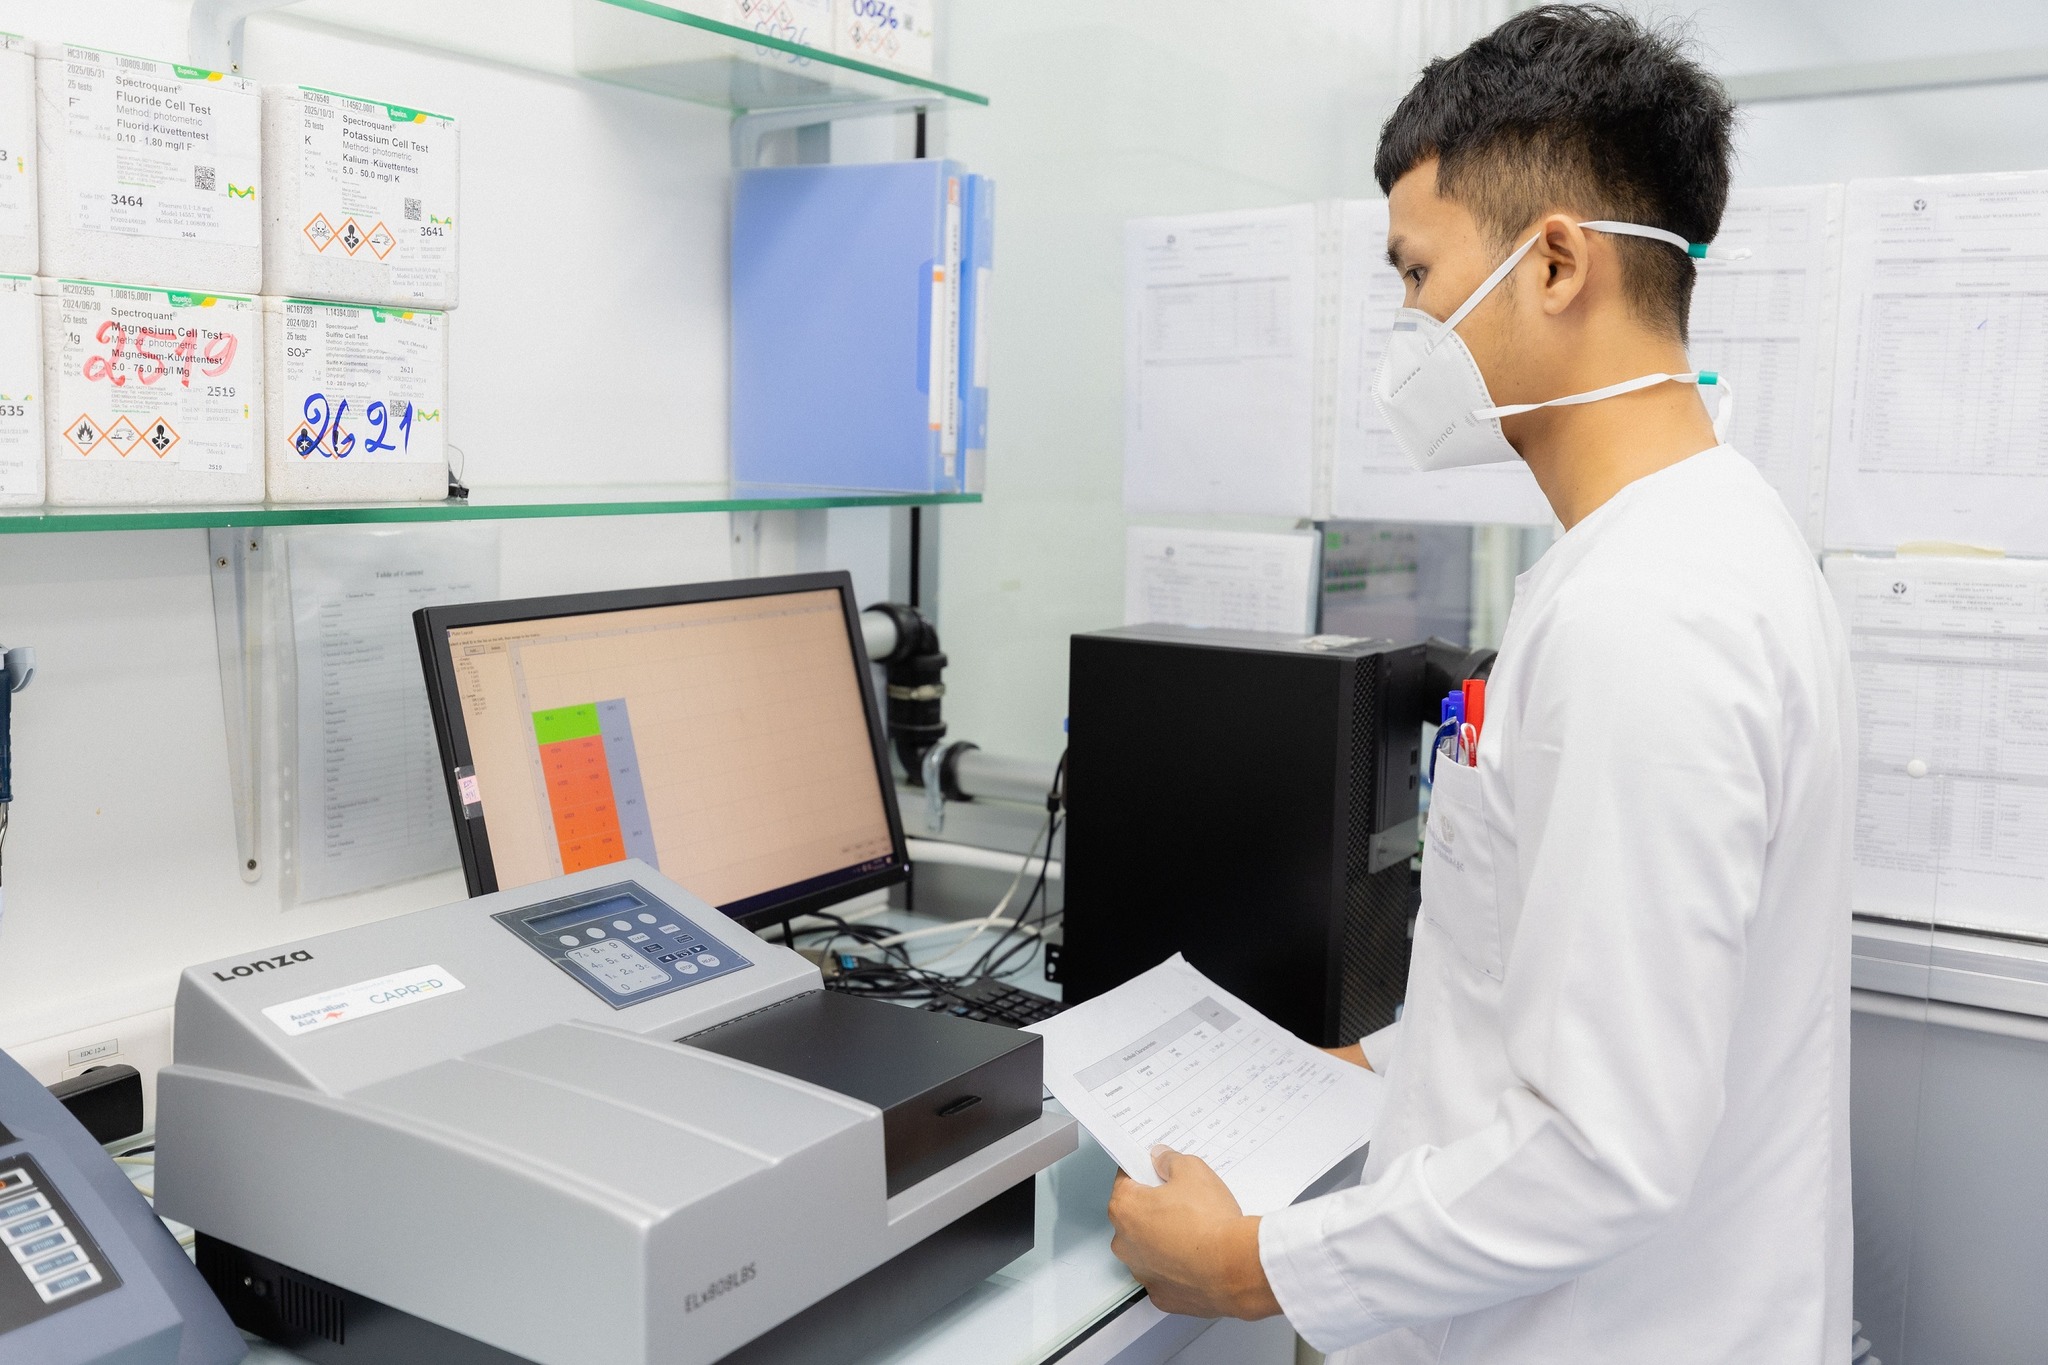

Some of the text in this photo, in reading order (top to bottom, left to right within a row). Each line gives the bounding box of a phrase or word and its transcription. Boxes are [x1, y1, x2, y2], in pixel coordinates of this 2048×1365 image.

[67, 48, 100, 63] HC317806
[115, 57, 157, 73] 1.00809.0001
[67, 64, 105, 79] 2025/05/31
[67, 79, 92, 92] 25 tests
[116, 91, 212, 116] Fluoride Cell Test
[303, 91, 375, 114] HC276549 1.14562.0001
[116, 105, 203, 127] Method: photometric
[304, 105, 334, 119] 2025/10/31
[117, 119, 209, 141] Fluorid-Küvettentest
[304, 119, 324, 131] 25 tests
[117, 133, 185, 152] 0.10 1.80 mg/l
[304, 135, 312, 145] K
[342, 128, 429, 154] Potassium Cell Test
[342, 141, 412, 161] Method: photometric
[342, 153, 369, 165] Kalium
[342, 166, 400, 183] 5.0 50.0 mg/l K
[111, 194, 143, 208] 3464
[420, 226, 444, 237] 3641
[63, 284, 95, 296] HC202955
[110, 289, 152, 302] 1.00815.0001
[63, 299, 101, 311] 2024/06/30
[63, 314, 88, 325] 25 tests
[325, 308, 360, 319] 1.14394.0001
[286, 318, 317, 329] 2024/08/31
[111, 322, 223, 341] Magnesium Cell Test
[286, 332, 307, 342] 25 tests
[325, 331, 343, 339] Sulfite
[344, 332, 356, 340] Cell
[111, 335, 198, 351] Method: photometric
[83, 320, 238, 387] 2519
[111, 363, 190, 378] 5.0 75.0 mg/l Mg
[400, 366, 414, 374] 2621
[207, 386, 236, 398] 2519
[0, 405, 24, 417] 635
[296, 393, 413, 459] 2621
[1426, 421, 1457, 458] winner
[208, 463, 222, 471] 2519
[574, 941, 618, 960] 7 8 9
[212, 949, 314, 983] Lonza
[590, 952, 630, 969] 4 5 6
[679, 956, 716, 972] STOP READ
[604, 963, 644, 981] 1 2 3
[620, 983, 631, 992] 0
[289, 1000, 349, 1024] Australian
[369, 978, 444, 1005] CAPRED
[297, 1017, 318, 1029] Aid
